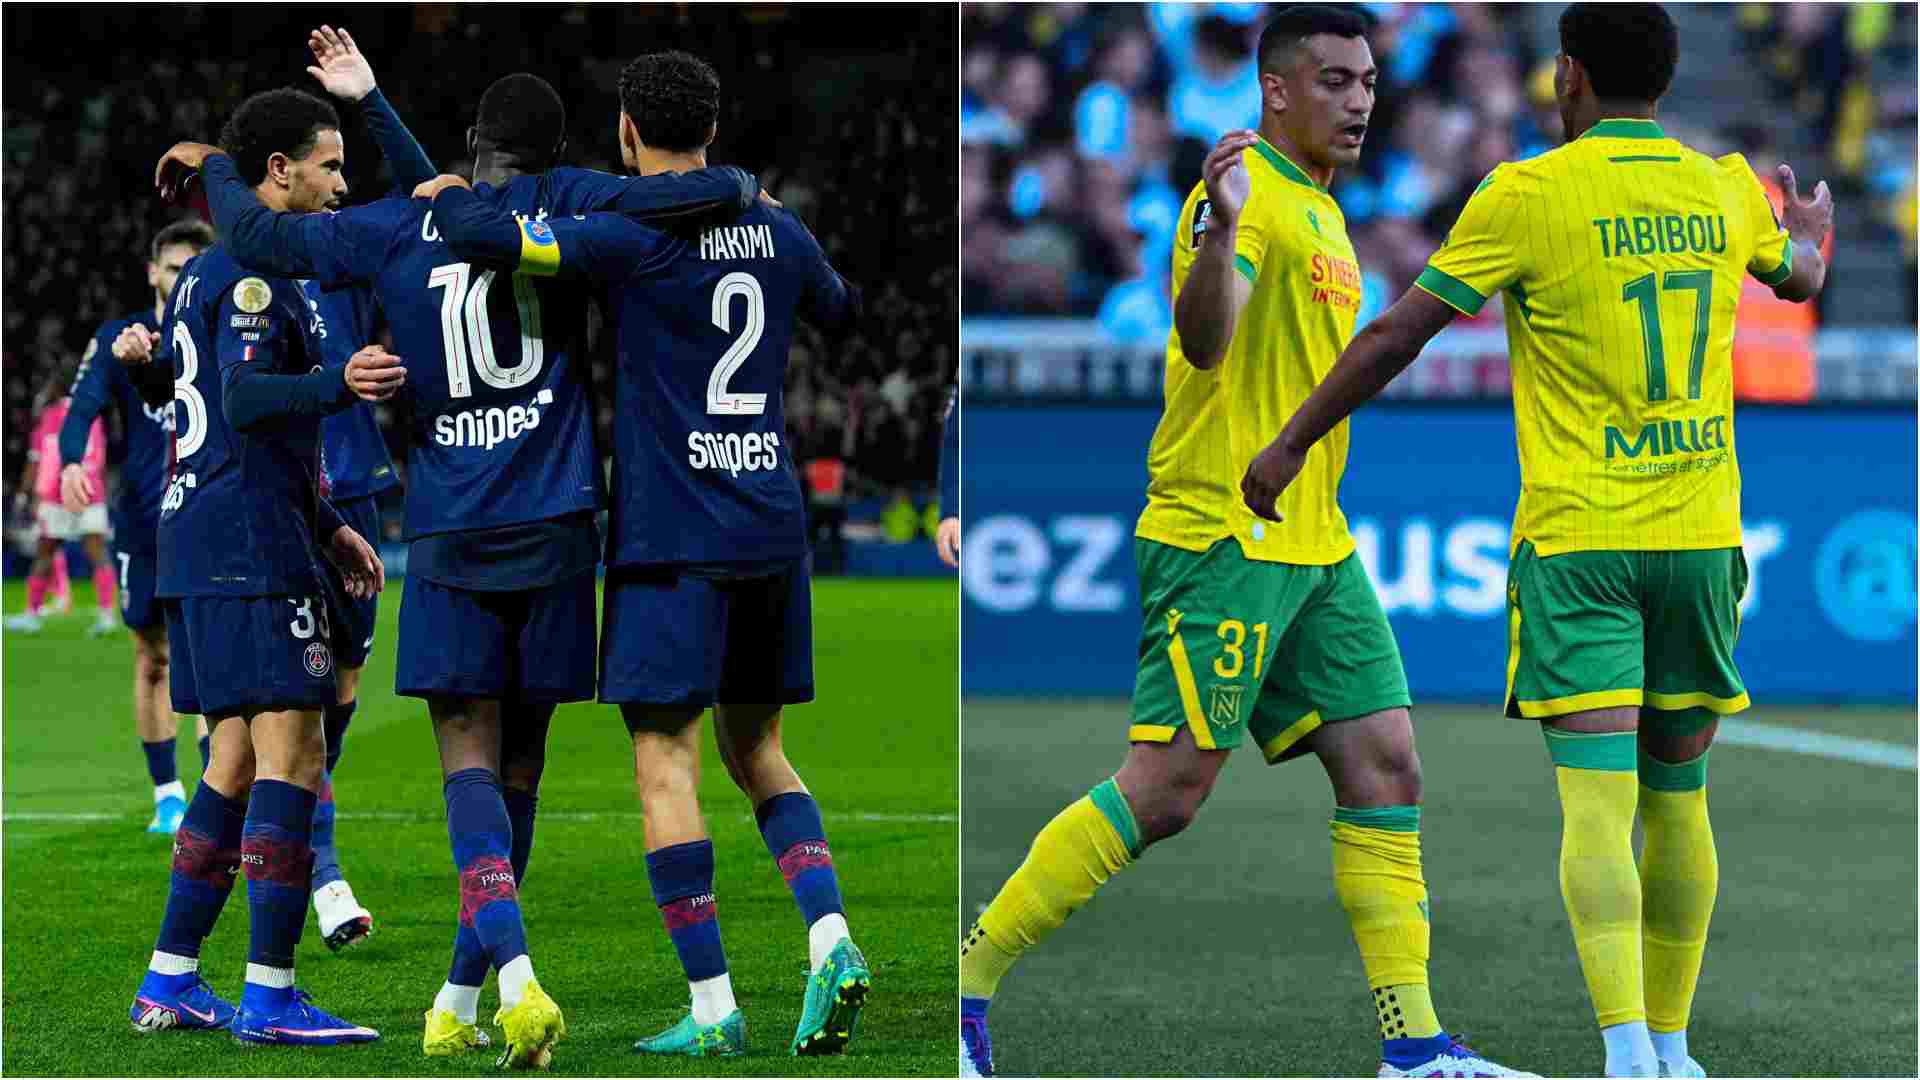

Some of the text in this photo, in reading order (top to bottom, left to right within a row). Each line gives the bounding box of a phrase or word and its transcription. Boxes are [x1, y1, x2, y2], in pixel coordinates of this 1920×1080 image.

[700, 223, 775, 260] HAKIMI
[1594, 215, 1727, 257] TABIBOU
[428, 261, 544, 398] 10
[705, 271, 768, 416] 2
[1622, 269, 1714, 401] 17
[434, 394, 550, 451] snipes
[1604, 415, 1726, 459] MILLET
[688, 430, 778, 477] snipes
[1214, 619, 1268, 680] 31
